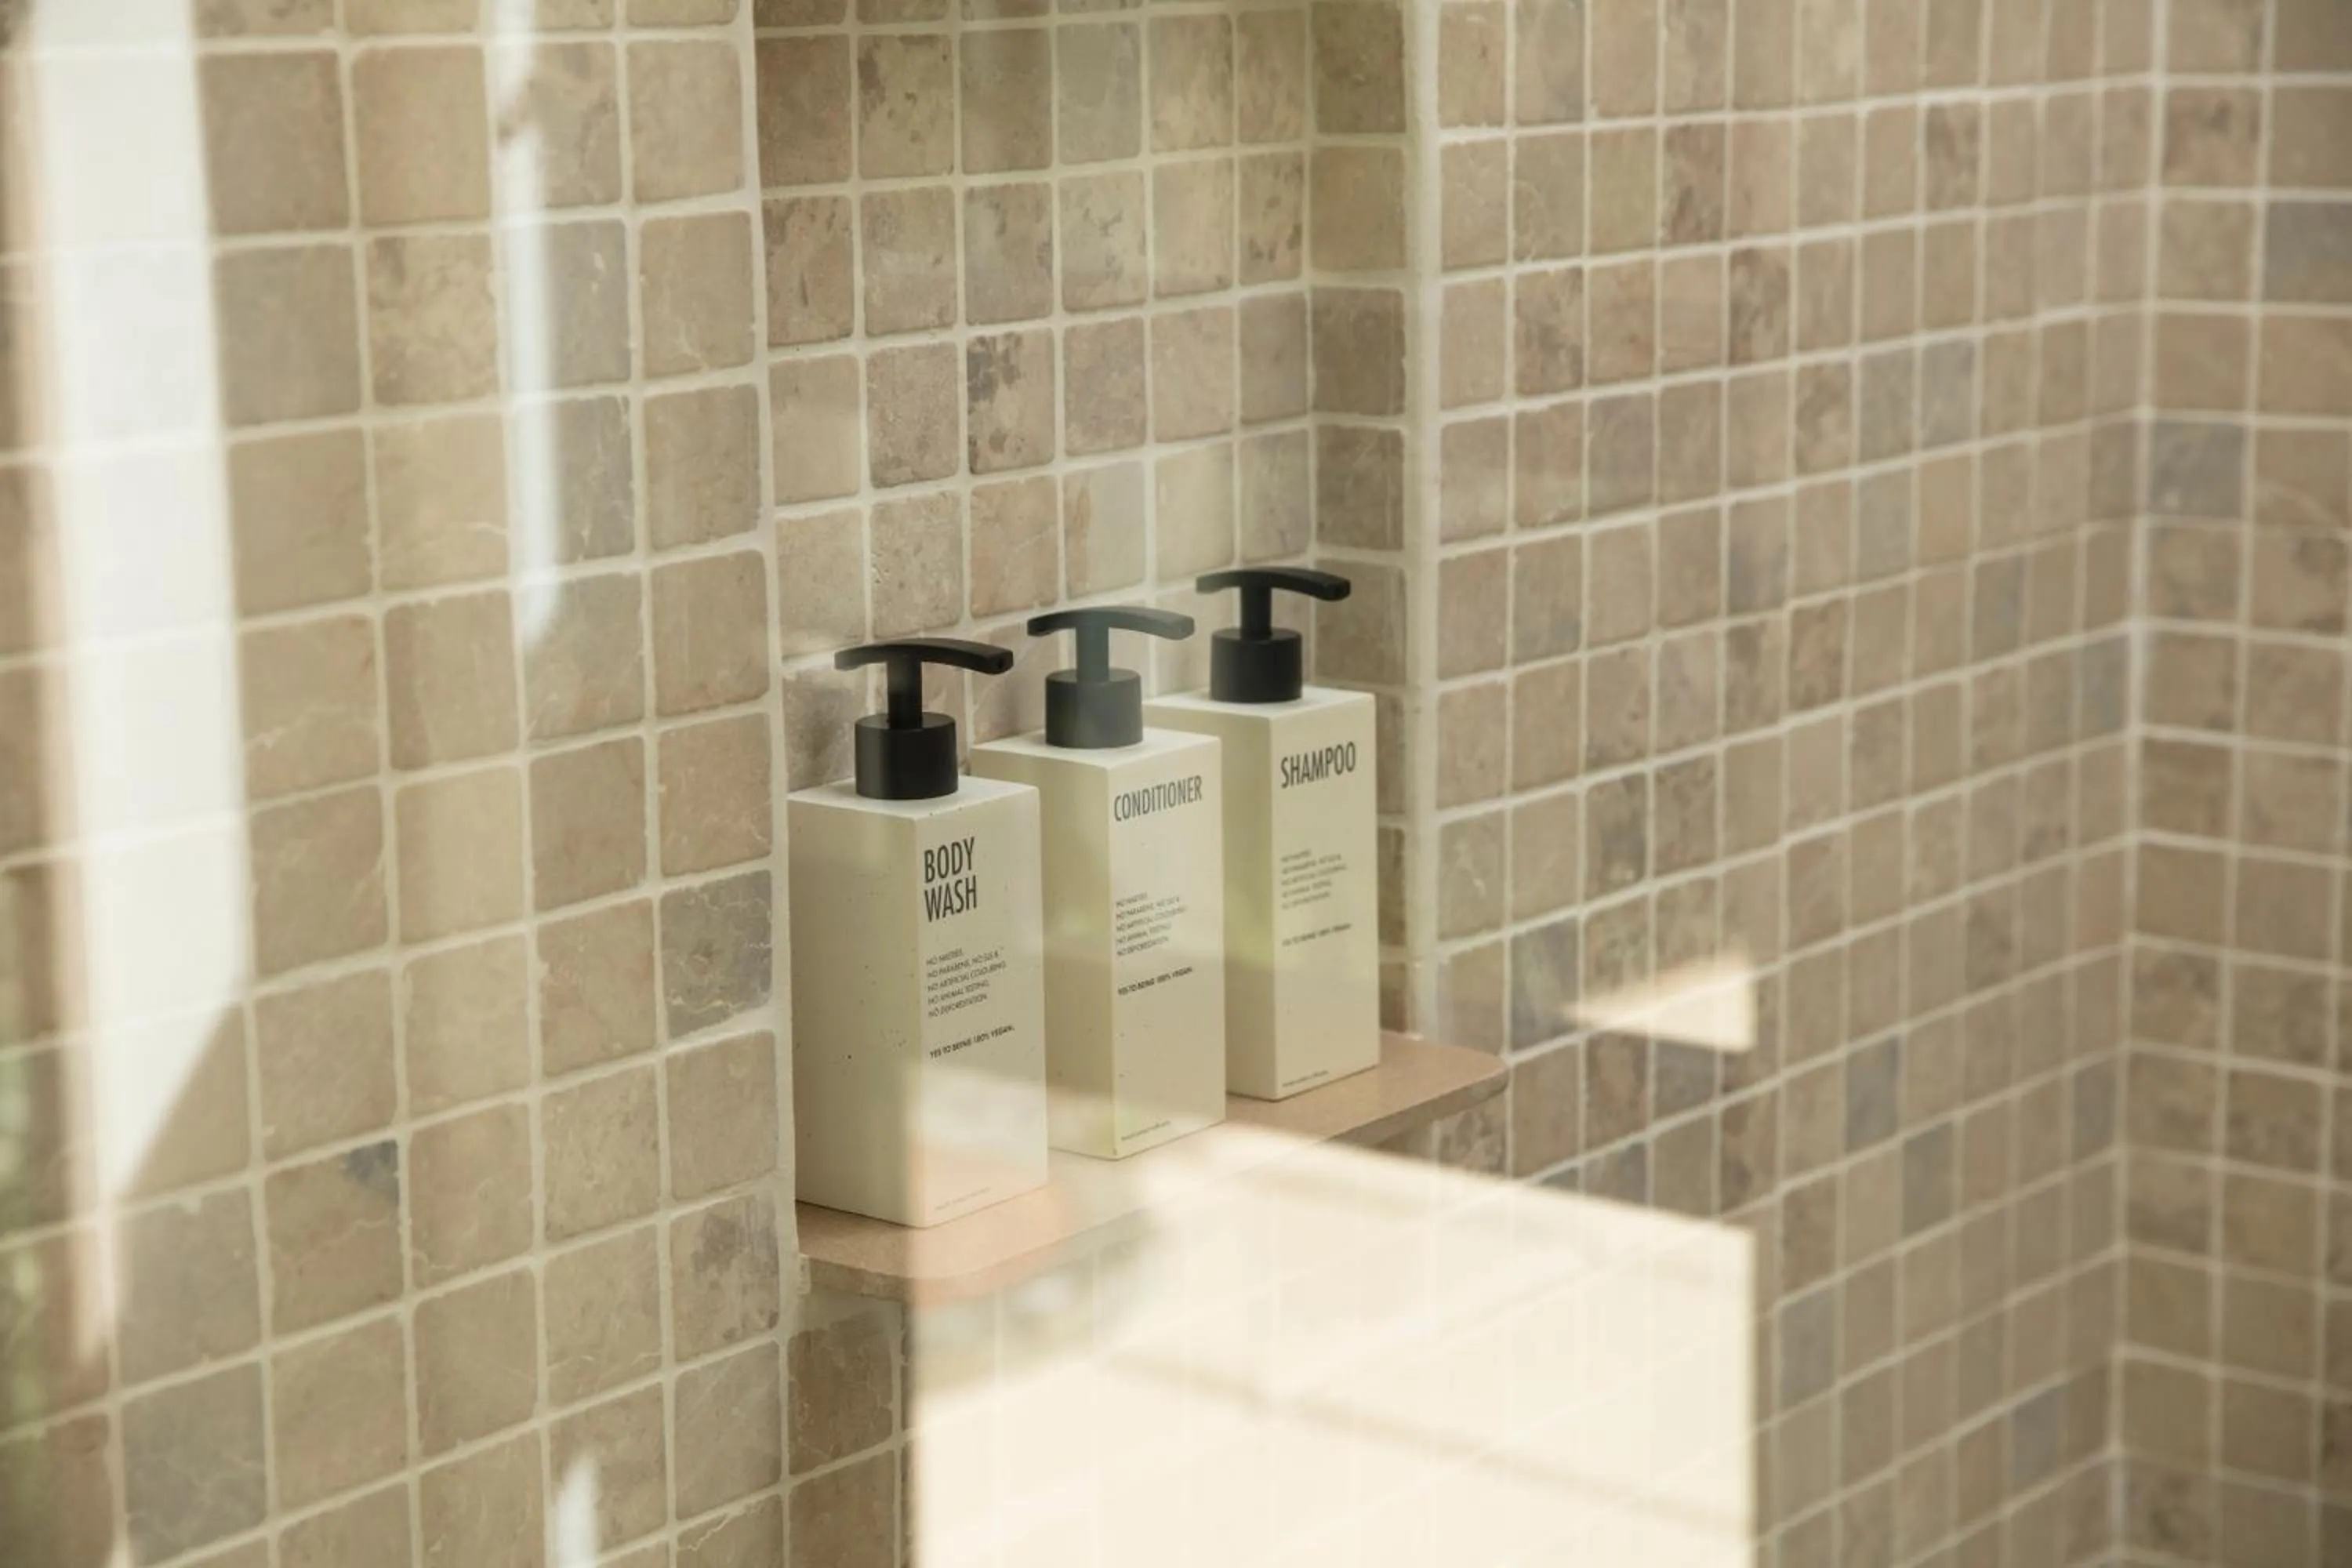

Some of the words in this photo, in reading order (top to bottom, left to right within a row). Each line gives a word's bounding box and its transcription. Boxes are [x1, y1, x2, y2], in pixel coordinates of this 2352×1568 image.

[1280, 741, 1356, 789] SHAMPOO
[1114, 775, 1203, 822] CONDITIONER
[924, 837, 975, 884] BODY
[924, 875, 977, 923] WASH
[926, 956, 938, 965] NO
[927, 969, 938, 978] NO
[927, 983, 938, 993] NO
[927, 995, 938, 1005] NO
[930, 1047, 942, 1058] YES
[942, 1045, 951, 1054] TO
